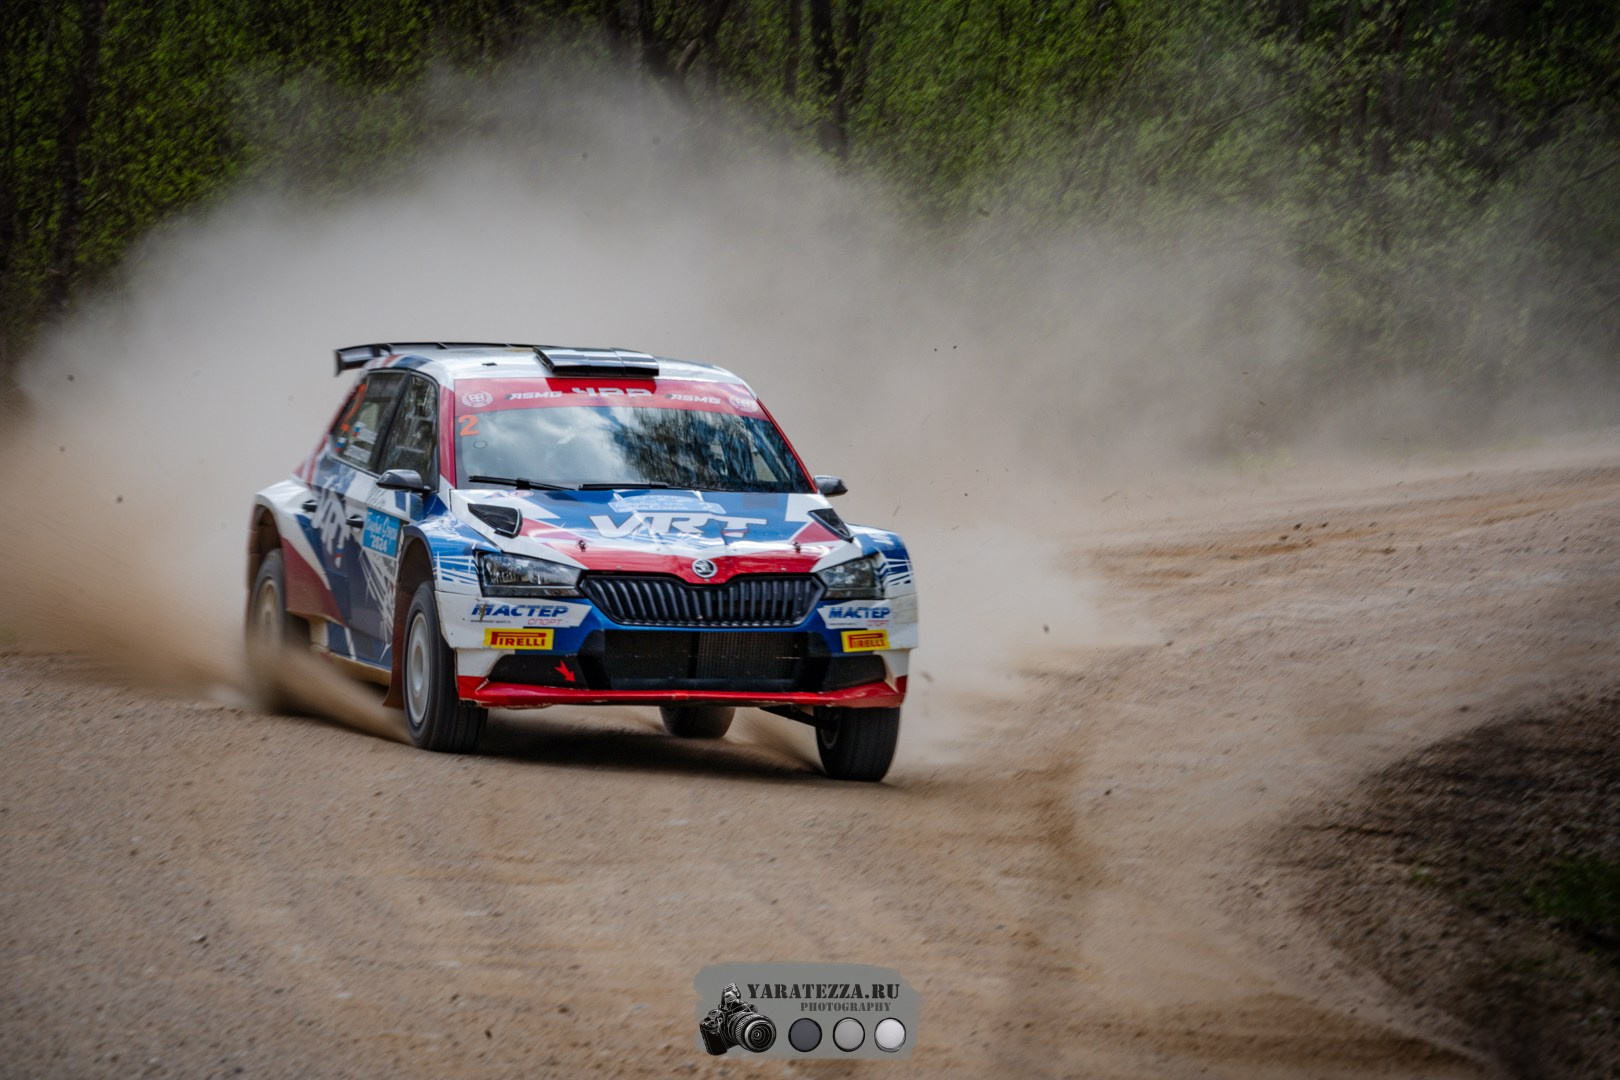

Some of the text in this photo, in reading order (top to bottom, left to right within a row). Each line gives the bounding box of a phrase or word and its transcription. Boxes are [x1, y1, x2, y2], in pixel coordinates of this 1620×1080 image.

[457, 414, 480, 437] 2
[588, 512, 767, 538] VRT
[471, 604, 569, 618] МАСТЕР
[828, 606, 891, 619] МАСТЕР
[527, 618, 563, 626] СПОРТ
[490, 631, 548, 647] PIRELLI
[847, 632, 886, 649] PIRELLI
